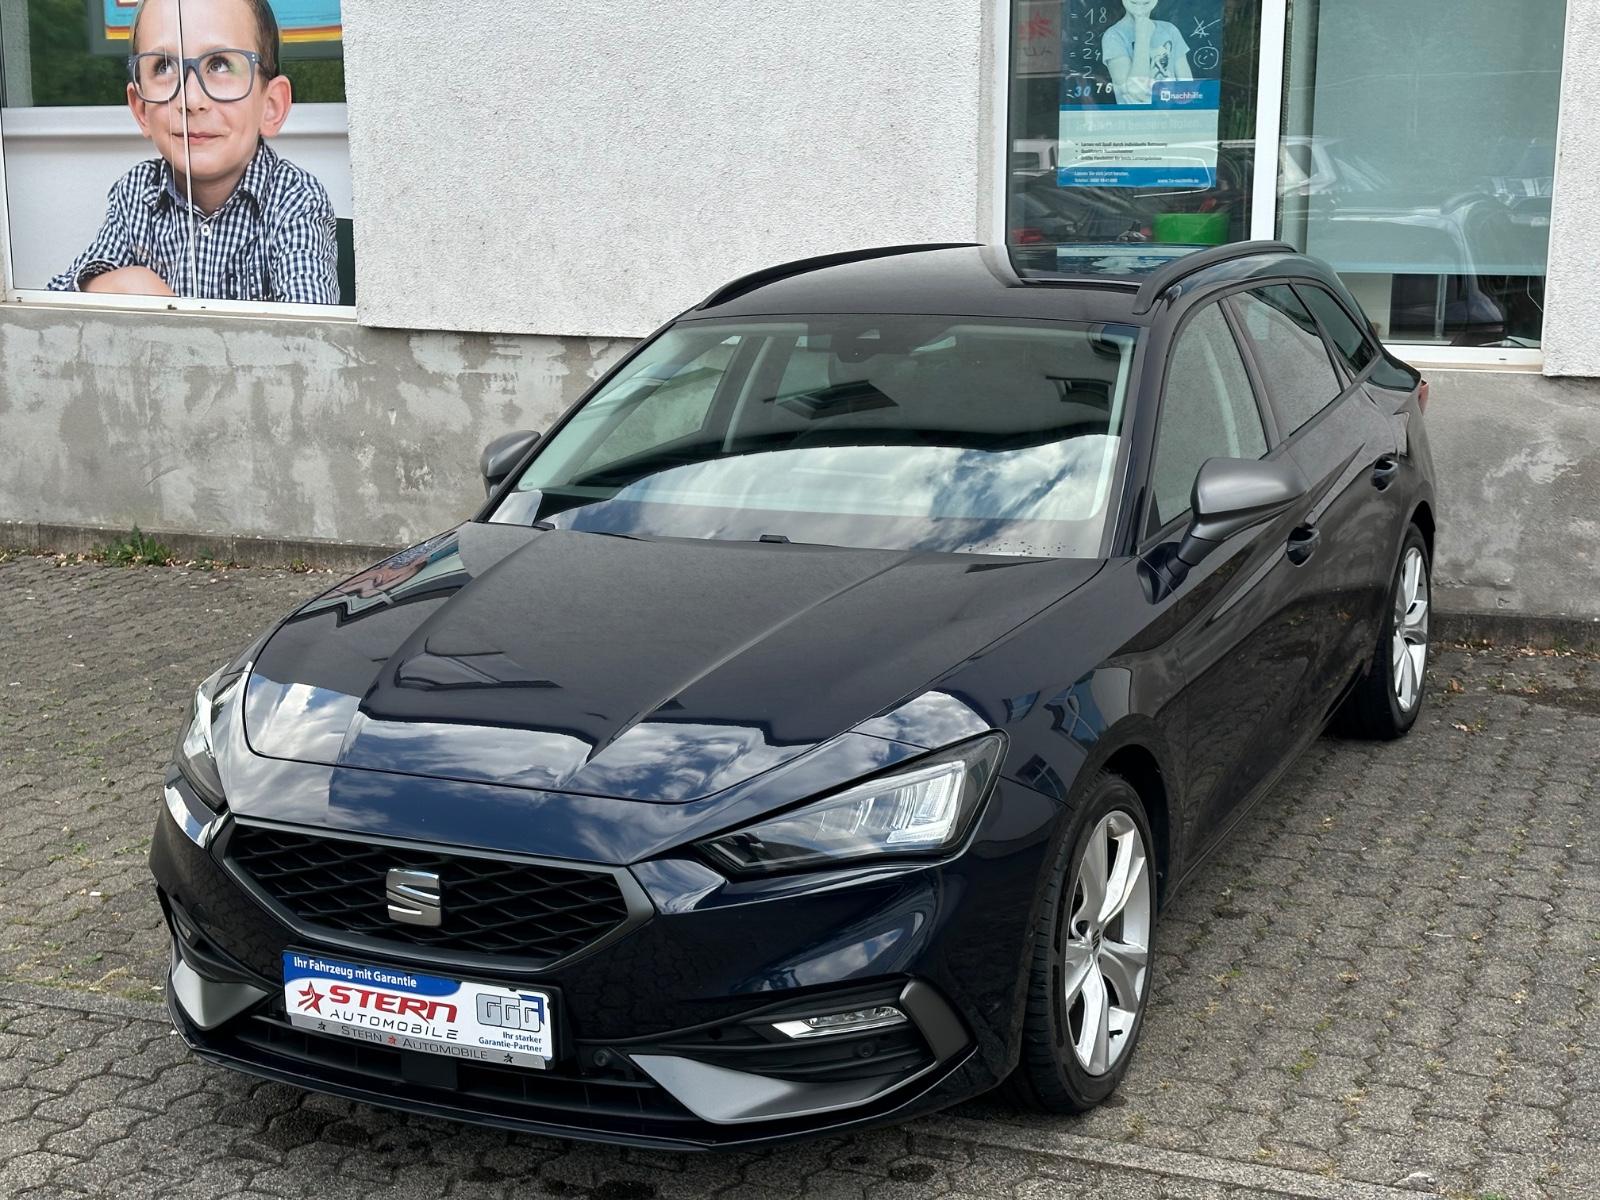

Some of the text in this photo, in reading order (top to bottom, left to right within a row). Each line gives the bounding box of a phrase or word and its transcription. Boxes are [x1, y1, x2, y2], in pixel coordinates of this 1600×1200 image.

[1084, 6, 1108, 25] 18
[1096, 82, 1113, 94] 76
[293, 956, 417, 988] Ihr Fahrzeug mit Garantie
[329, 984, 458, 1025] STERN
[330, 1009, 459, 1040] AUTOMOBILE
[341, 1025, 488, 1059] STERN AUTOMOBILE
[478, 1036, 543, 1053] Garantie-Partner
[502, 1031, 542, 1044] Ihr starker
